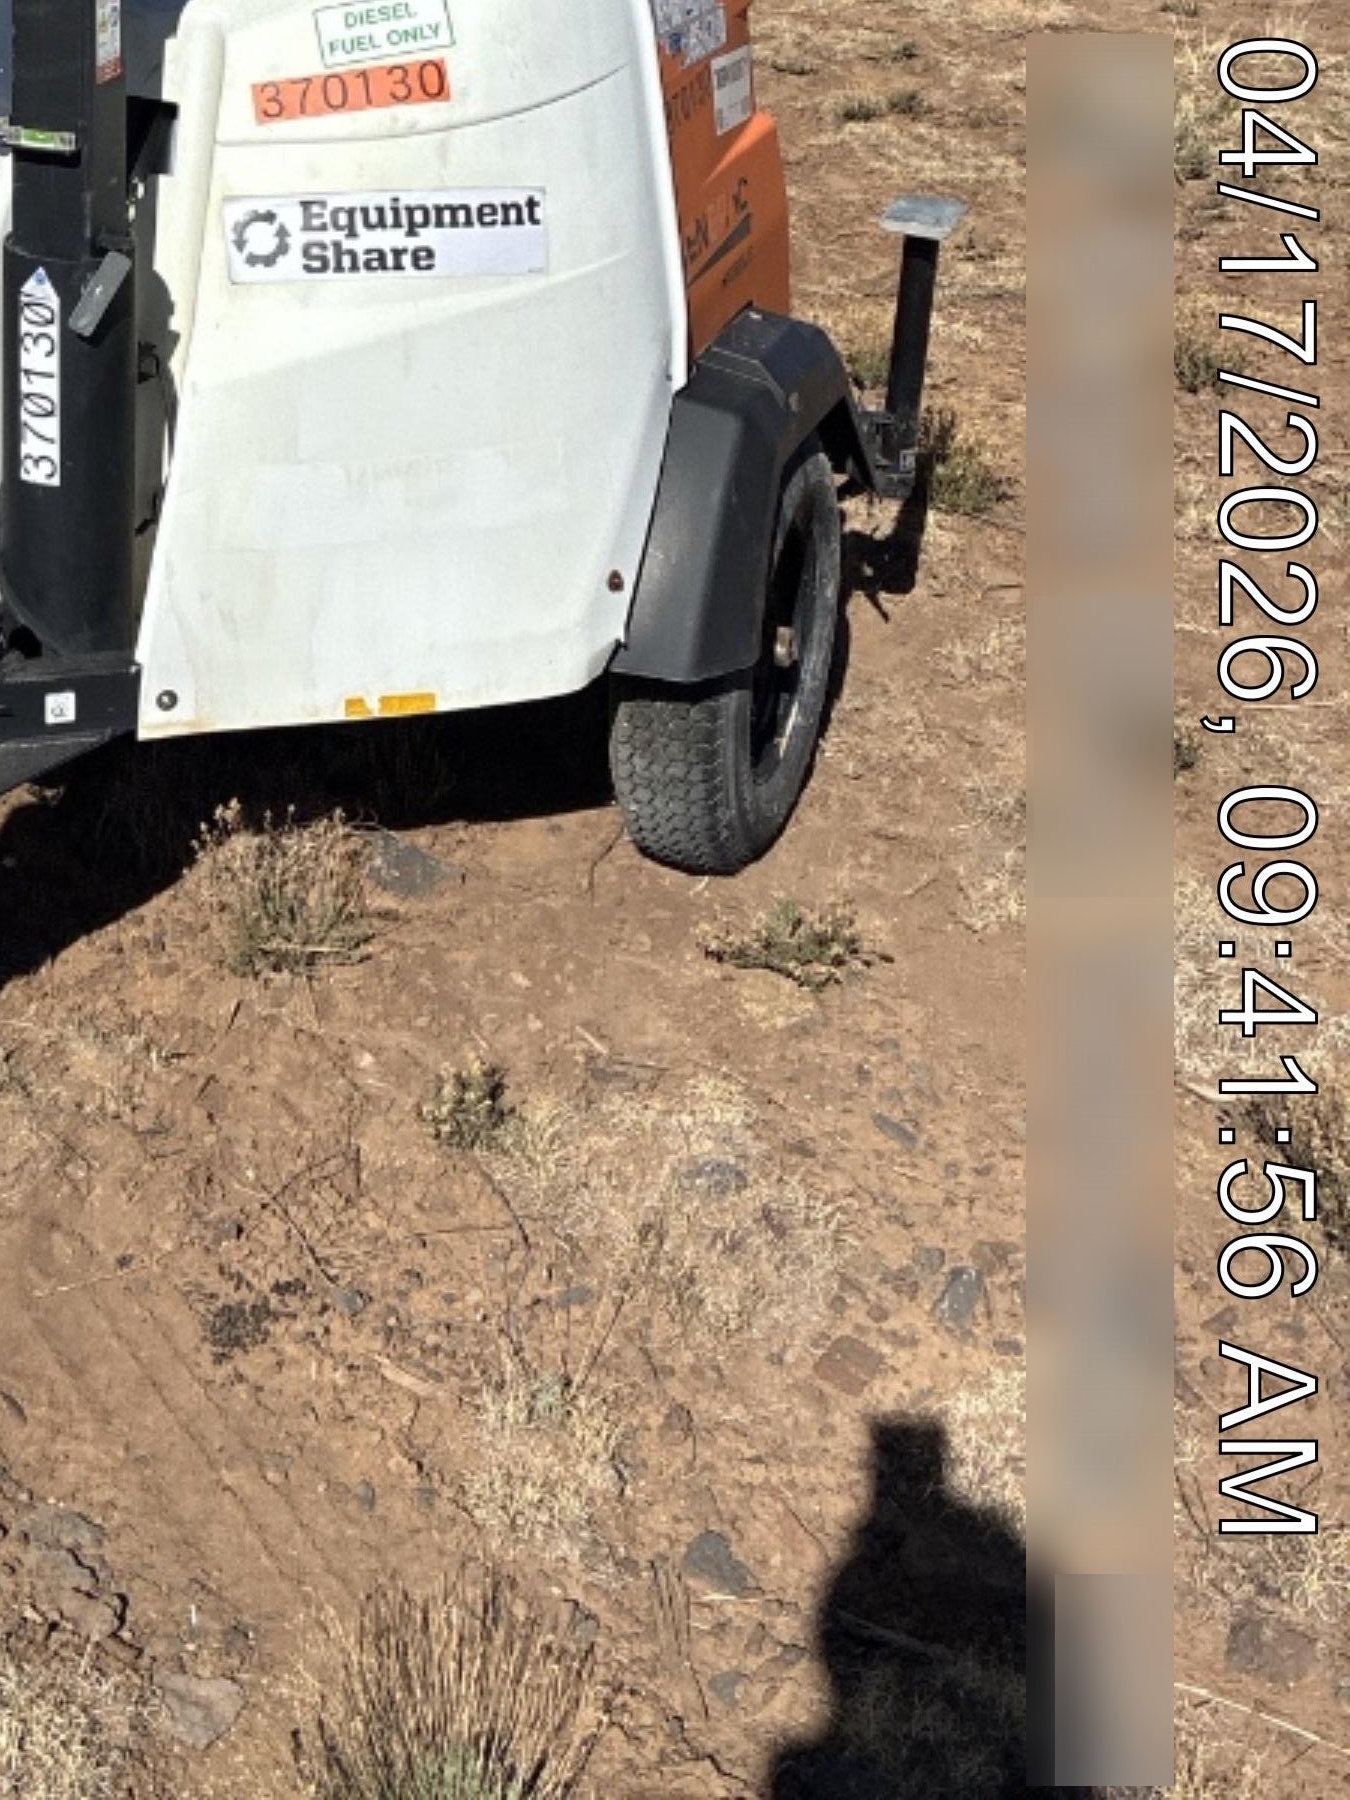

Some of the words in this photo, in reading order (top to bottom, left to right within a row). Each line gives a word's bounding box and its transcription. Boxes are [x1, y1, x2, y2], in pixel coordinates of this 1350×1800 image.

[344, 2, 418, 28] DIESEL
[328, 34, 381, 56] FUEL
[386, 22, 441, 47] ONLY
[260, 59, 446, 119] 370130
[299, 195, 541, 239] Equipment
[301, 240, 436, 274] Share
[22, 301, 58, 480] 370130
